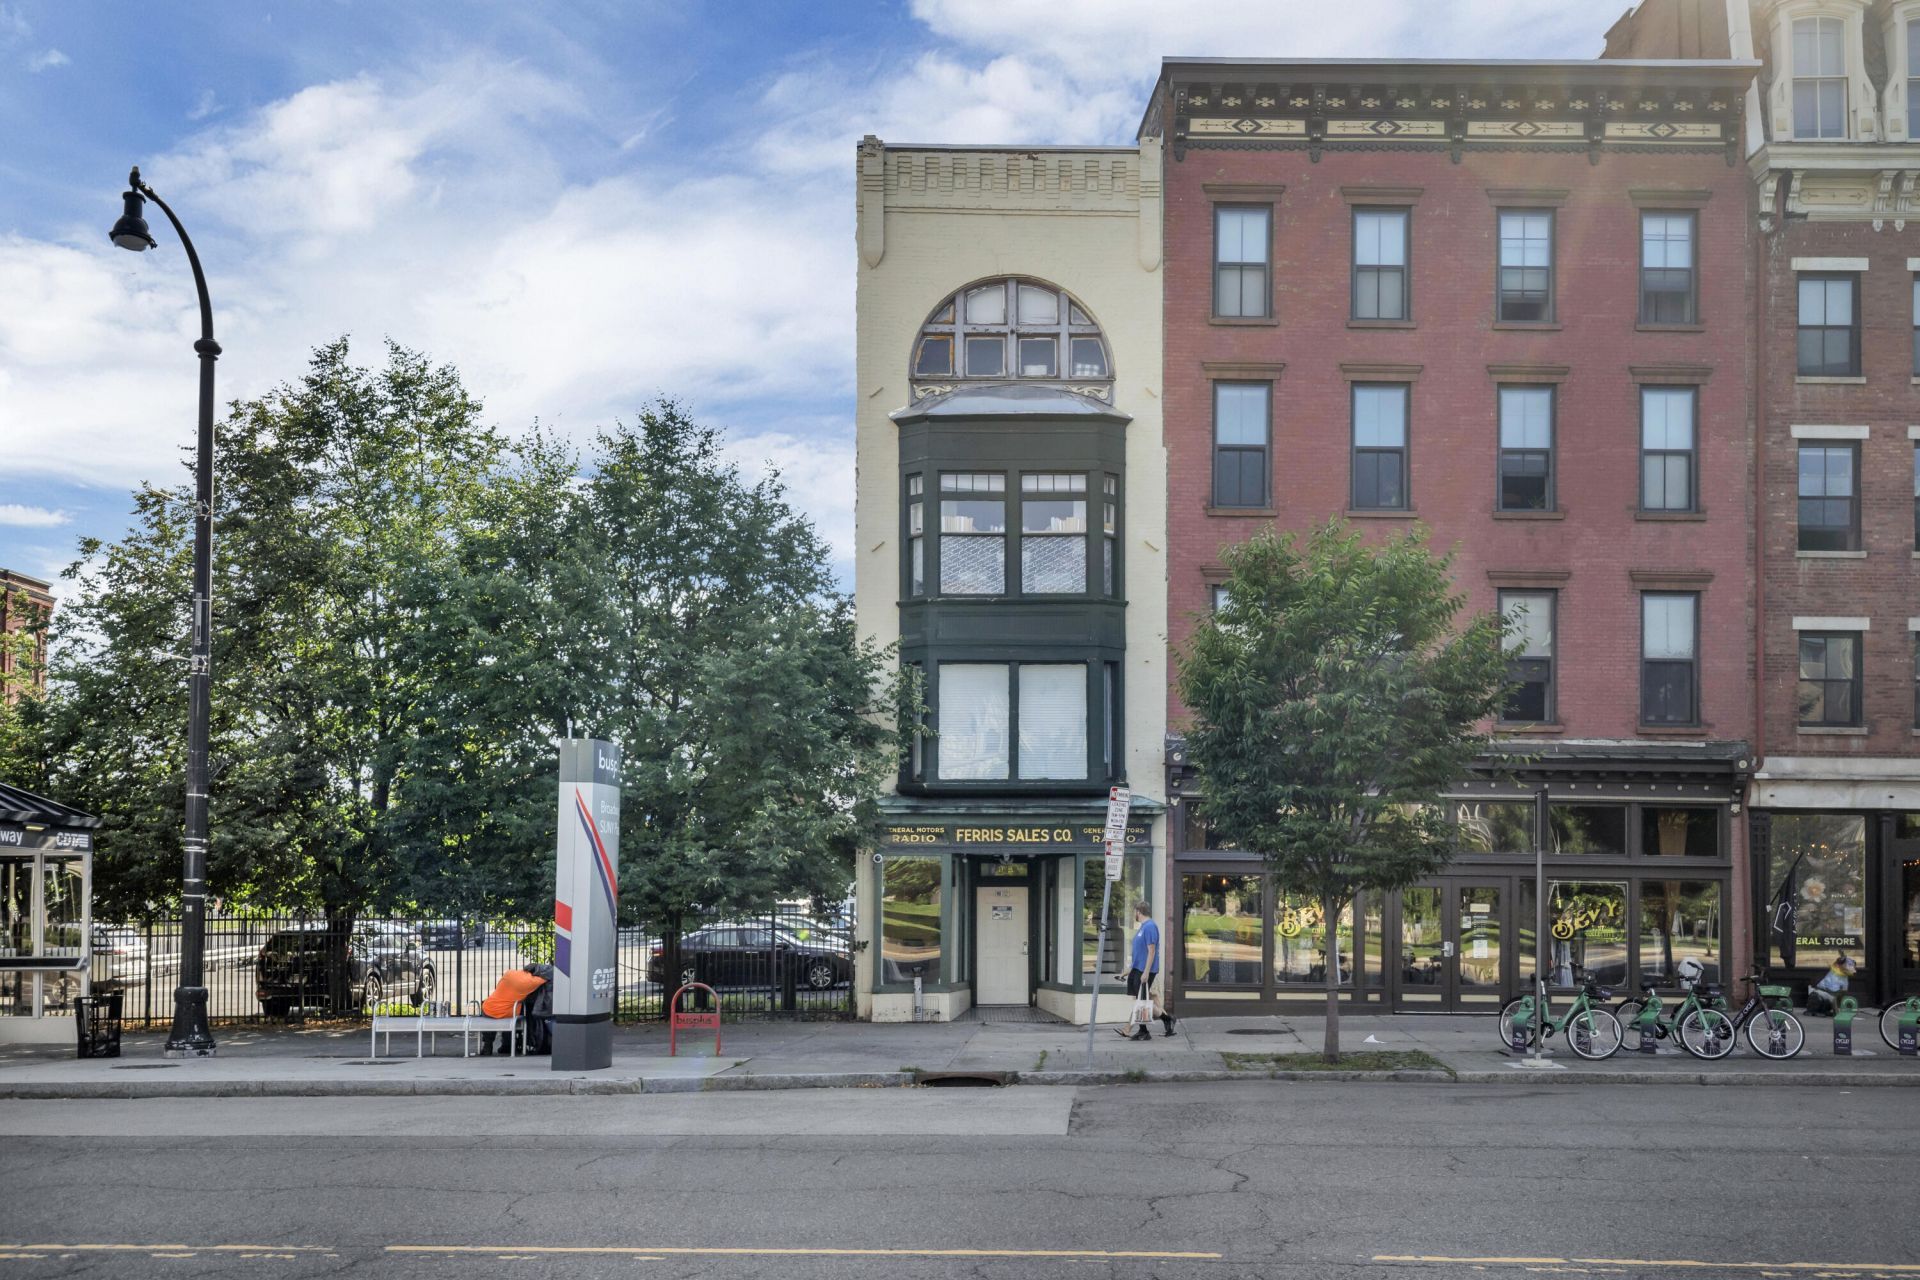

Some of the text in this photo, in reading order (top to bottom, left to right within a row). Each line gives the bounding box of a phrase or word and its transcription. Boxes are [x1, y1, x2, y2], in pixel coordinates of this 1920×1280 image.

[892, 834, 936, 843] RADIO
[956, 828, 1073, 842] FERRIS SALES CO.
[1823, 937, 1856, 946] STORE
